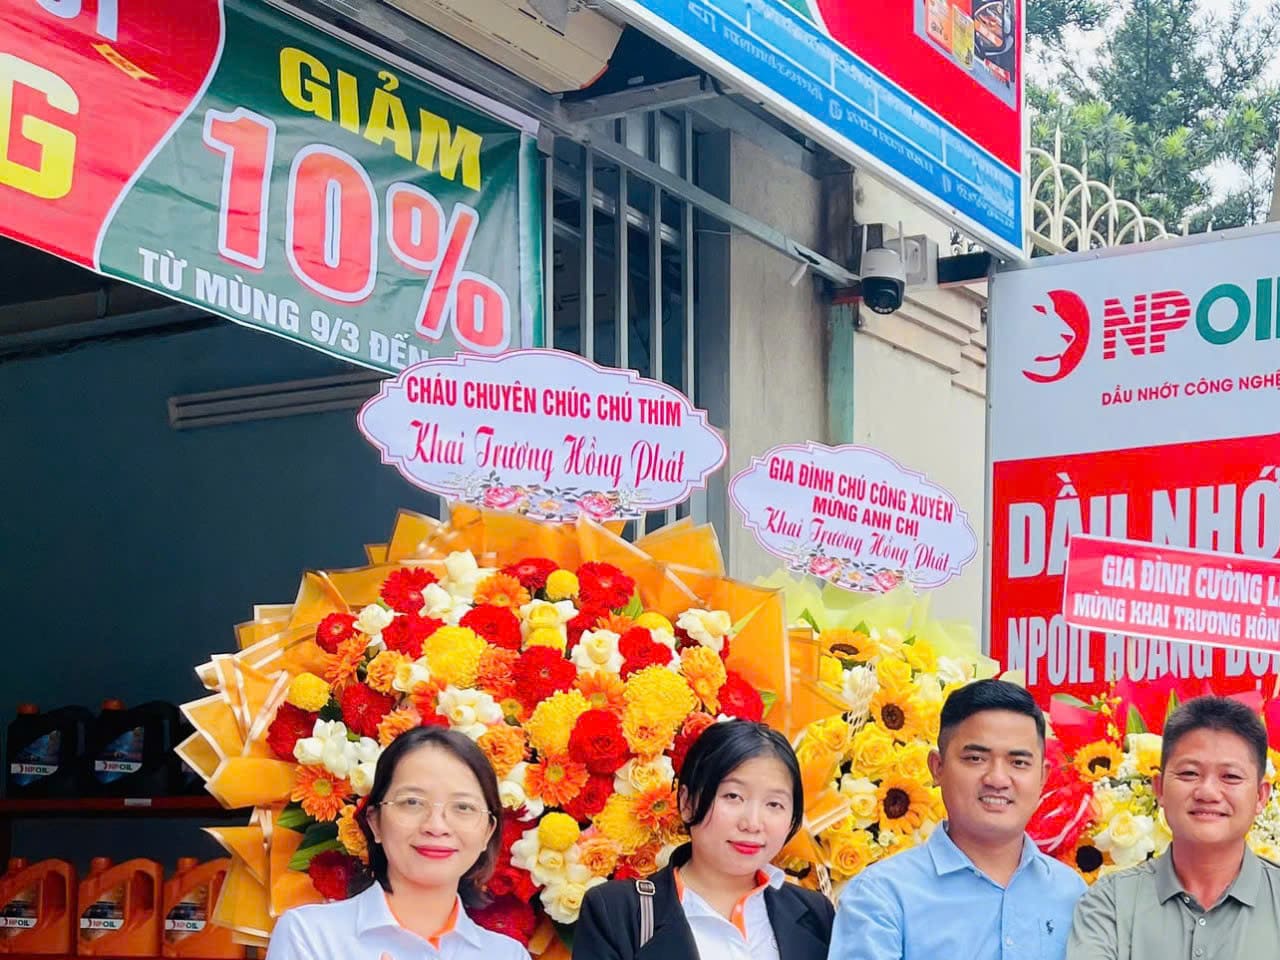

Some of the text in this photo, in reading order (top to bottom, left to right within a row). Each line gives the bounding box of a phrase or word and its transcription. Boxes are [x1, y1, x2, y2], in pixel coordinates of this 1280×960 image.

[279, 46, 484, 190] GIẢM
[203, 106, 512, 356] 10%
[138, 247, 429, 370] TỪ MÙNG 9/3 ĐẾN
[406, 372, 681, 428] CHÁU CHUYÊN CHÚC CHÚ THÍM
[1101, 384, 1133, 406] DẦU
[1137, 381, 1180, 402] NHỚT
[1184, 377, 1234, 396] CÔNG
[405, 419, 685, 489] Khai Trương Hồng Phát
[769, 456, 954, 524] GIA ĐÌNH CHÚ CÔNG XUYÊN
[812, 495, 920, 541] MỪNG ANH CHỊ
[762, 506, 803, 538] Khai
[913, 542, 950, 572] Phát
[1102, 554, 1135, 590] GIA
[1140, 554, 1192, 597] ĐÌNH
[1195, 563, 1263, 606] CƯỜNG
[1073, 590, 1126, 622] MỪNG
[1129, 600, 1171, 629] KHAI
[1173, 606, 1241, 638] TRƯƠNG
[1008, 614, 1094, 686] NPOIL
